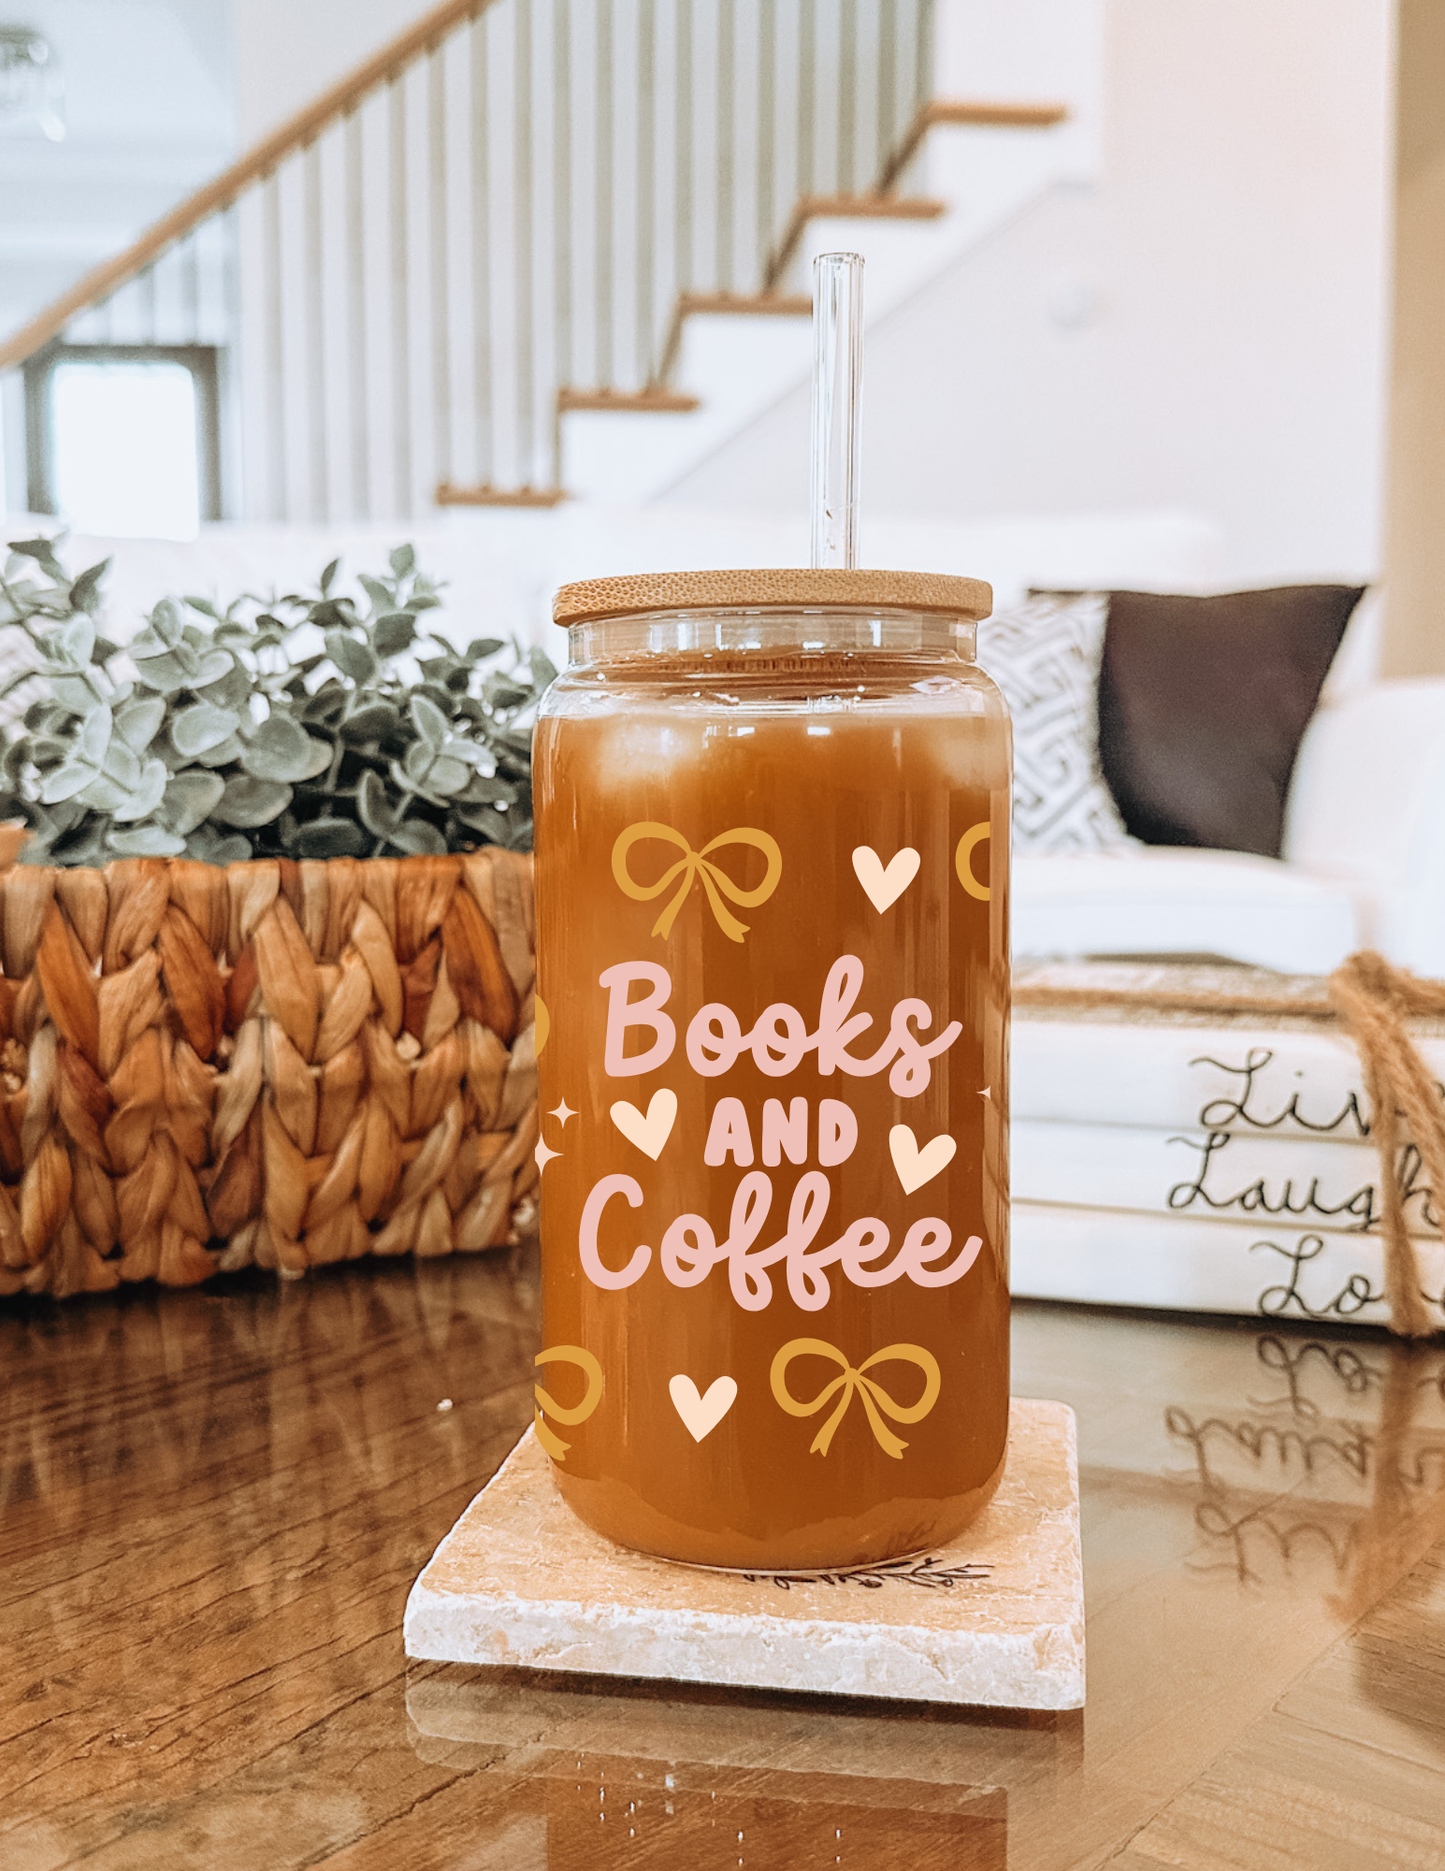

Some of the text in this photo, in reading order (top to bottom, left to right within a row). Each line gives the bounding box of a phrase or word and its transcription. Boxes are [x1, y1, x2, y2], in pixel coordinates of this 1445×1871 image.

[599, 954, 963, 1098] Books
[704, 1096, 858, 1167] AND
[578, 1171, 983, 1312] Coffee
[1249, 1234, 1445, 1318] Lo
